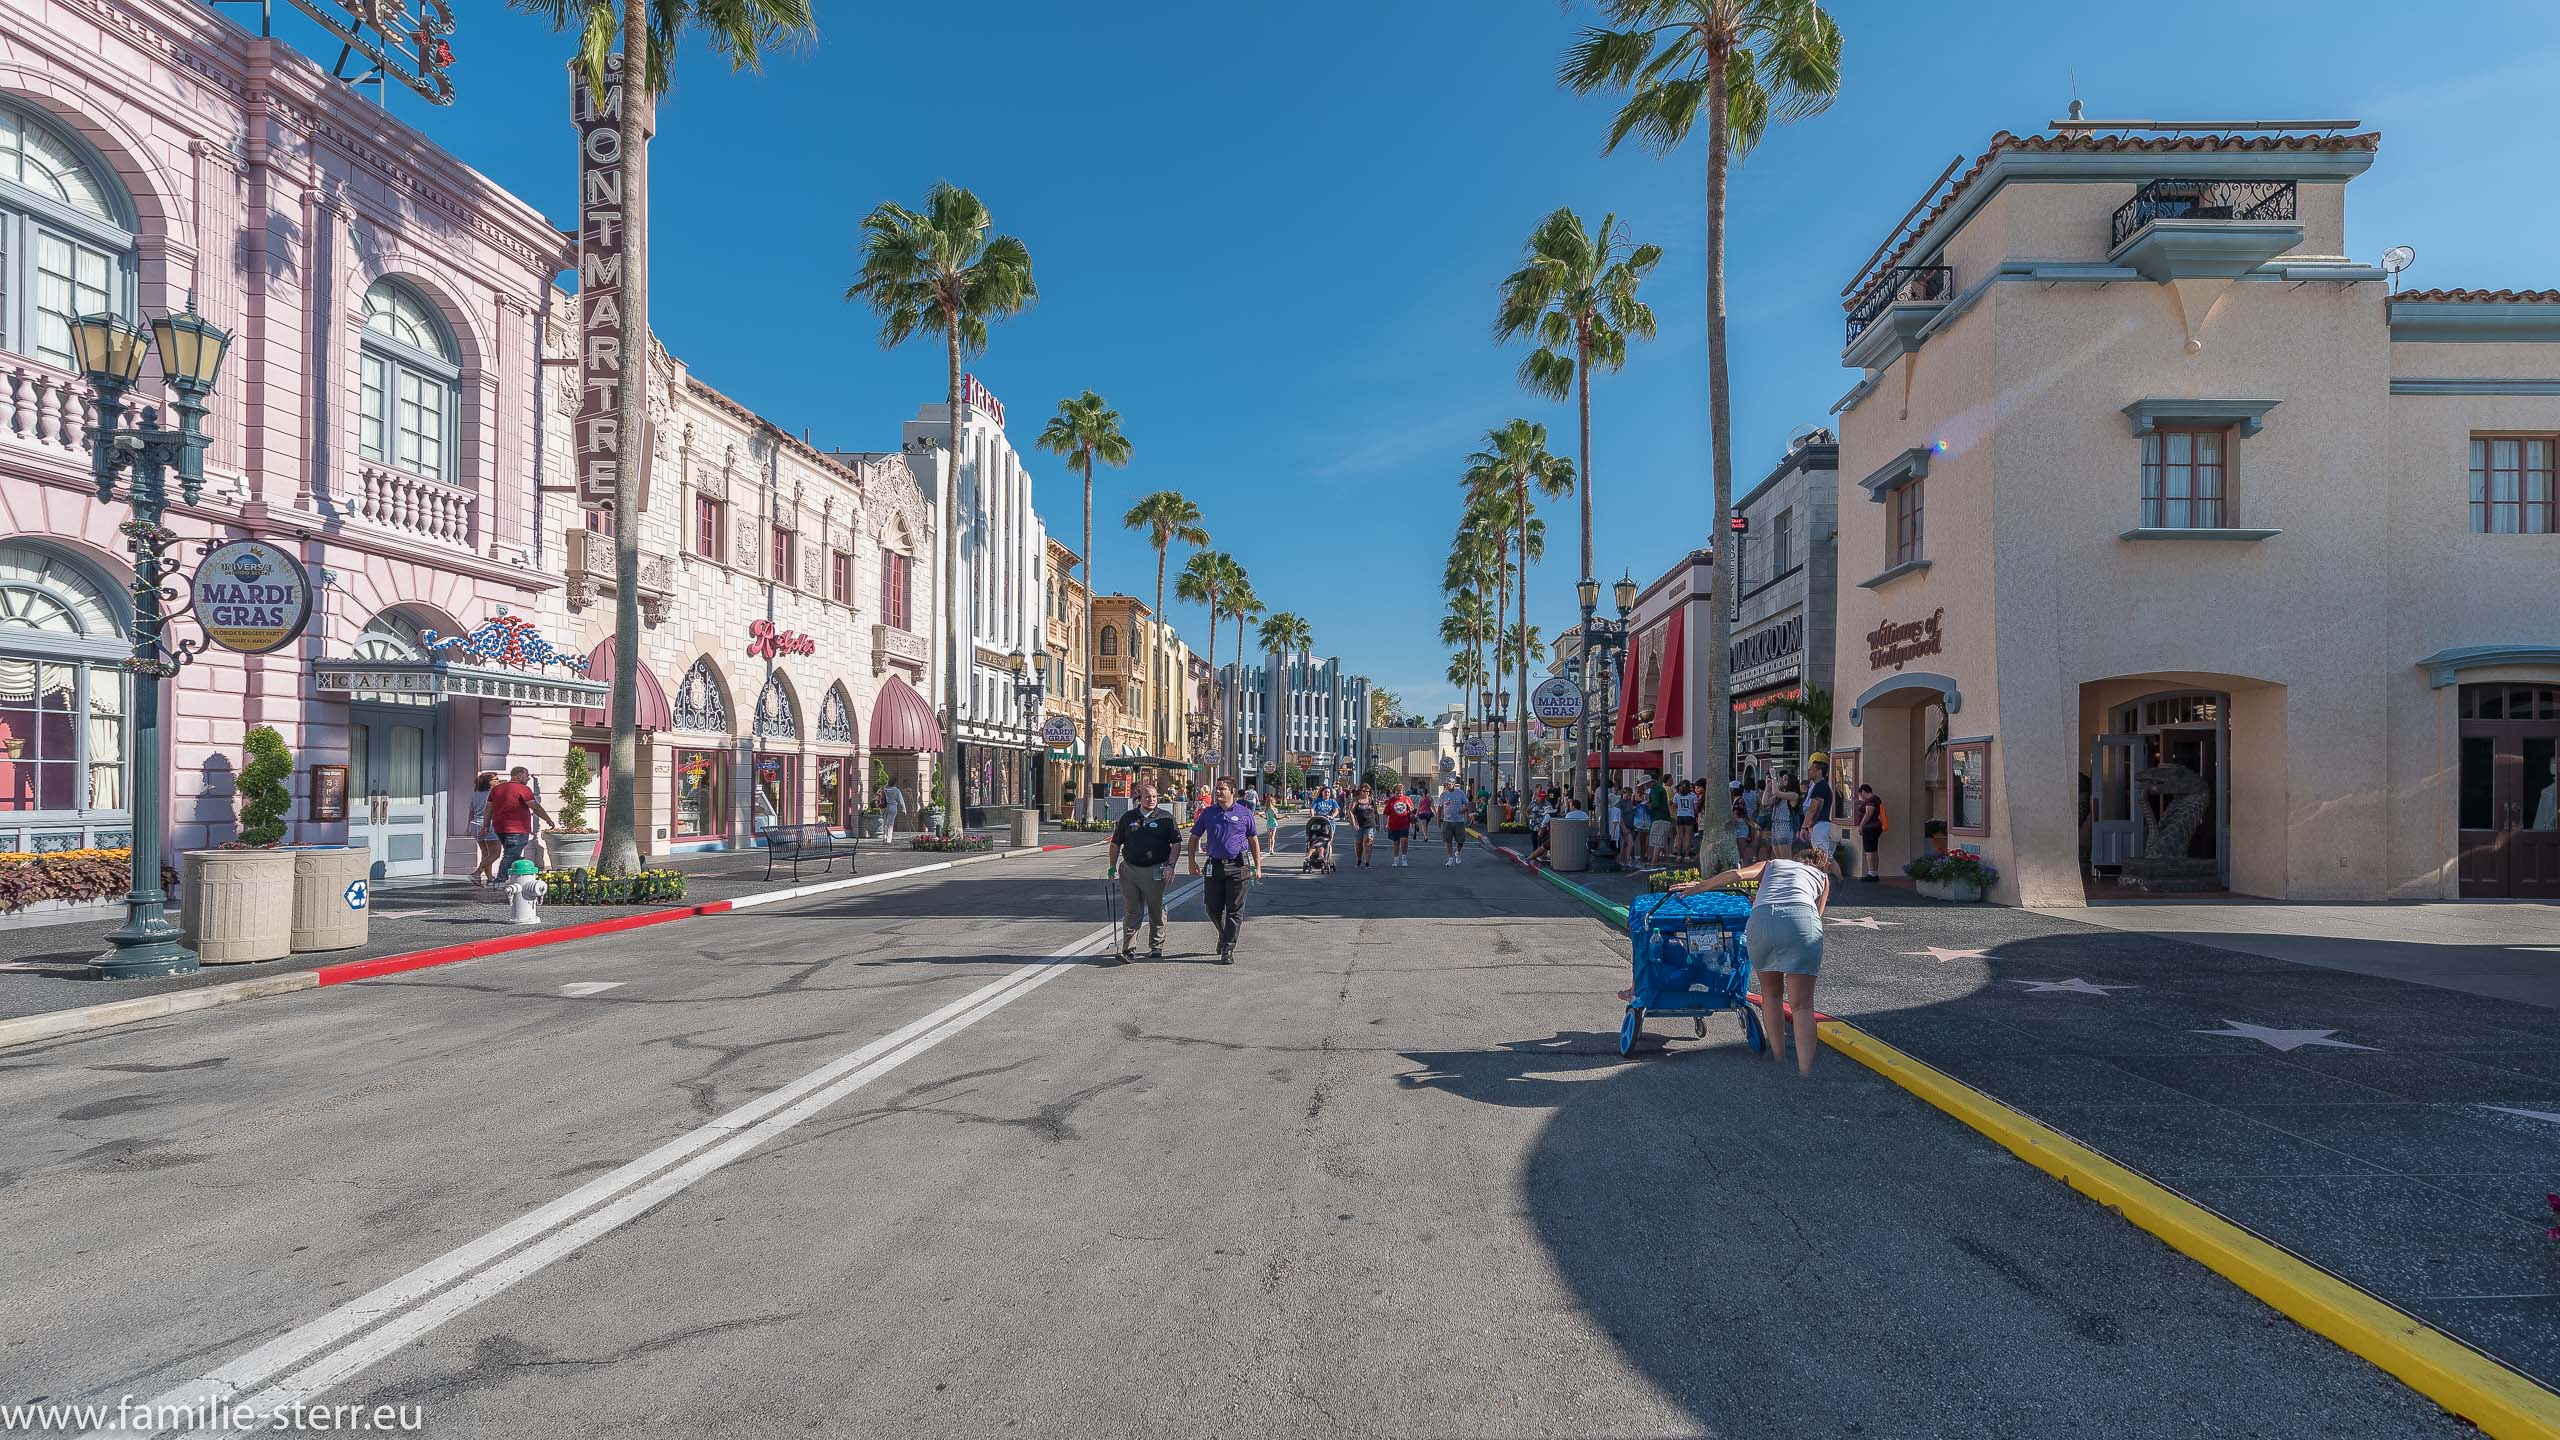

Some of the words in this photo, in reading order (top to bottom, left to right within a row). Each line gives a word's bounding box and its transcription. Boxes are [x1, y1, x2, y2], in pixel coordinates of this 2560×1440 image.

[584, 86, 623, 494] MONTMARTRE
[965, 372, 1005, 430] KRESS
[202, 584, 294, 604] MARDI
[212, 606, 284, 627] GRAS
[1866, 618, 1925, 650] Williams
[1925, 607, 1944, 639] of
[747, 619, 816, 661] Ralphs
[1731, 615, 1803, 672] DARKROOM
[1870, 628, 1943, 671] Hollywood
[338, 675, 413, 688] CAFE
[449, 680, 593, 704] MONTMARTRE
[1538, 697, 1580, 706] MARDI
[1543, 707, 1575, 716] GRAS
[1680, 799, 1690, 808] 10
